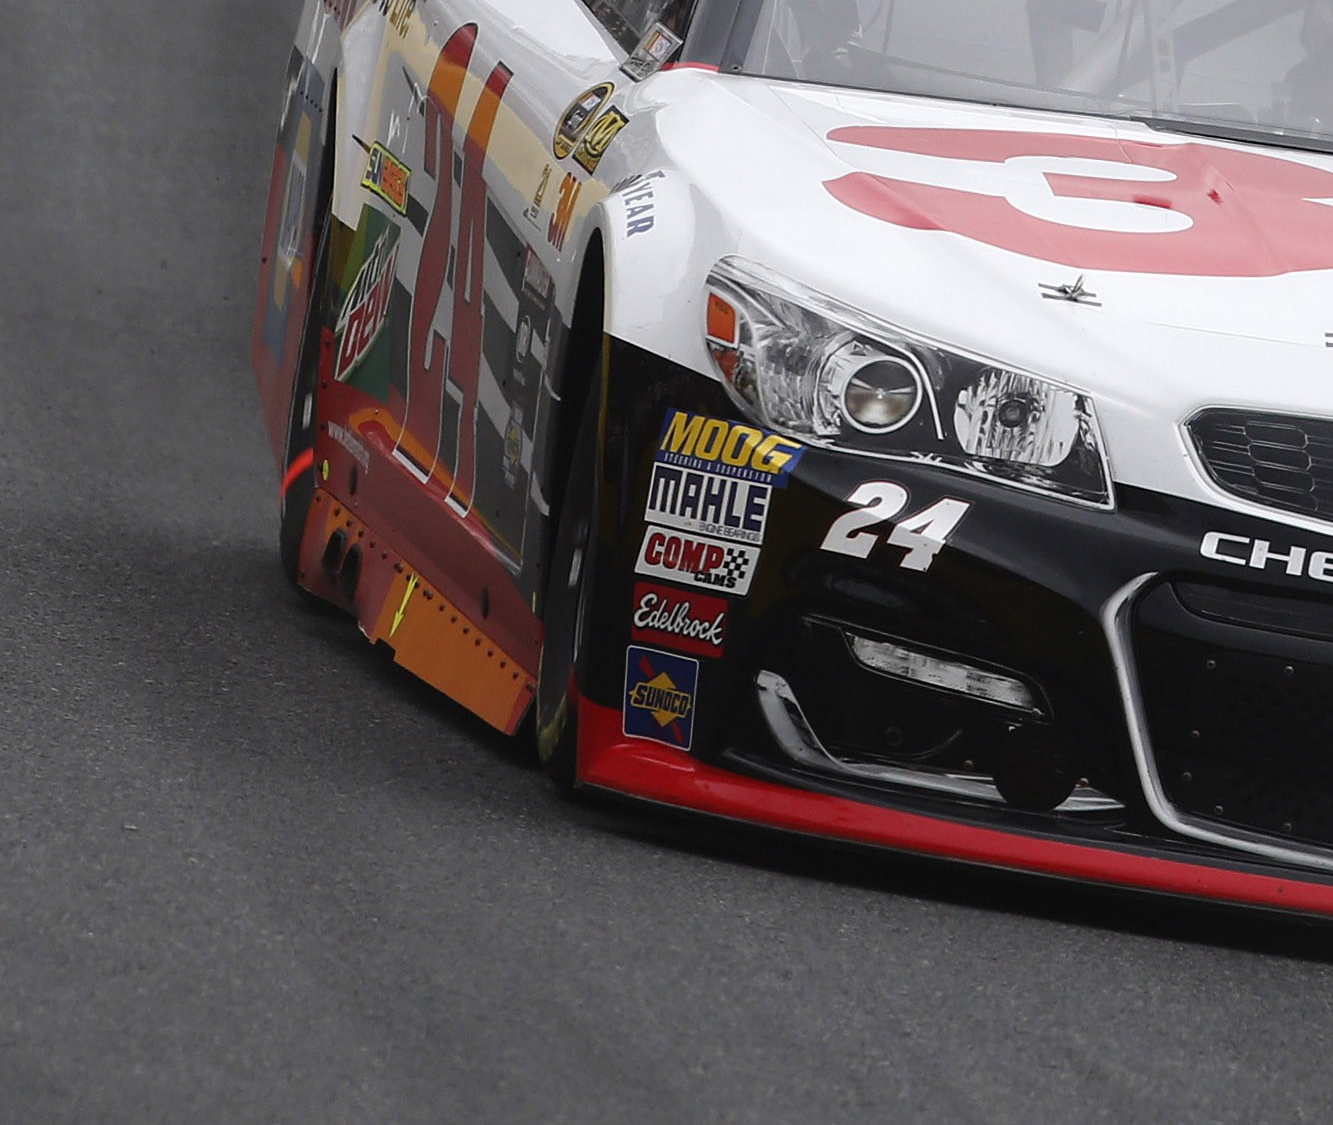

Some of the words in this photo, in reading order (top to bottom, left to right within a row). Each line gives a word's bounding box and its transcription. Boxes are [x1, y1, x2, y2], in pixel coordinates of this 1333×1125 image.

[660, 411, 803, 474] MOOG
[716, 463, 773, 483] SUSPENSION
[649, 466, 769, 532] MAHLE
[819, 479, 975, 573] 24
[644, 532, 725, 574] COMP
[694, 572, 737, 589] CAMS
[633, 593, 725, 646] Edelbrock
[631, 684, 691, 718] SUNOCO
